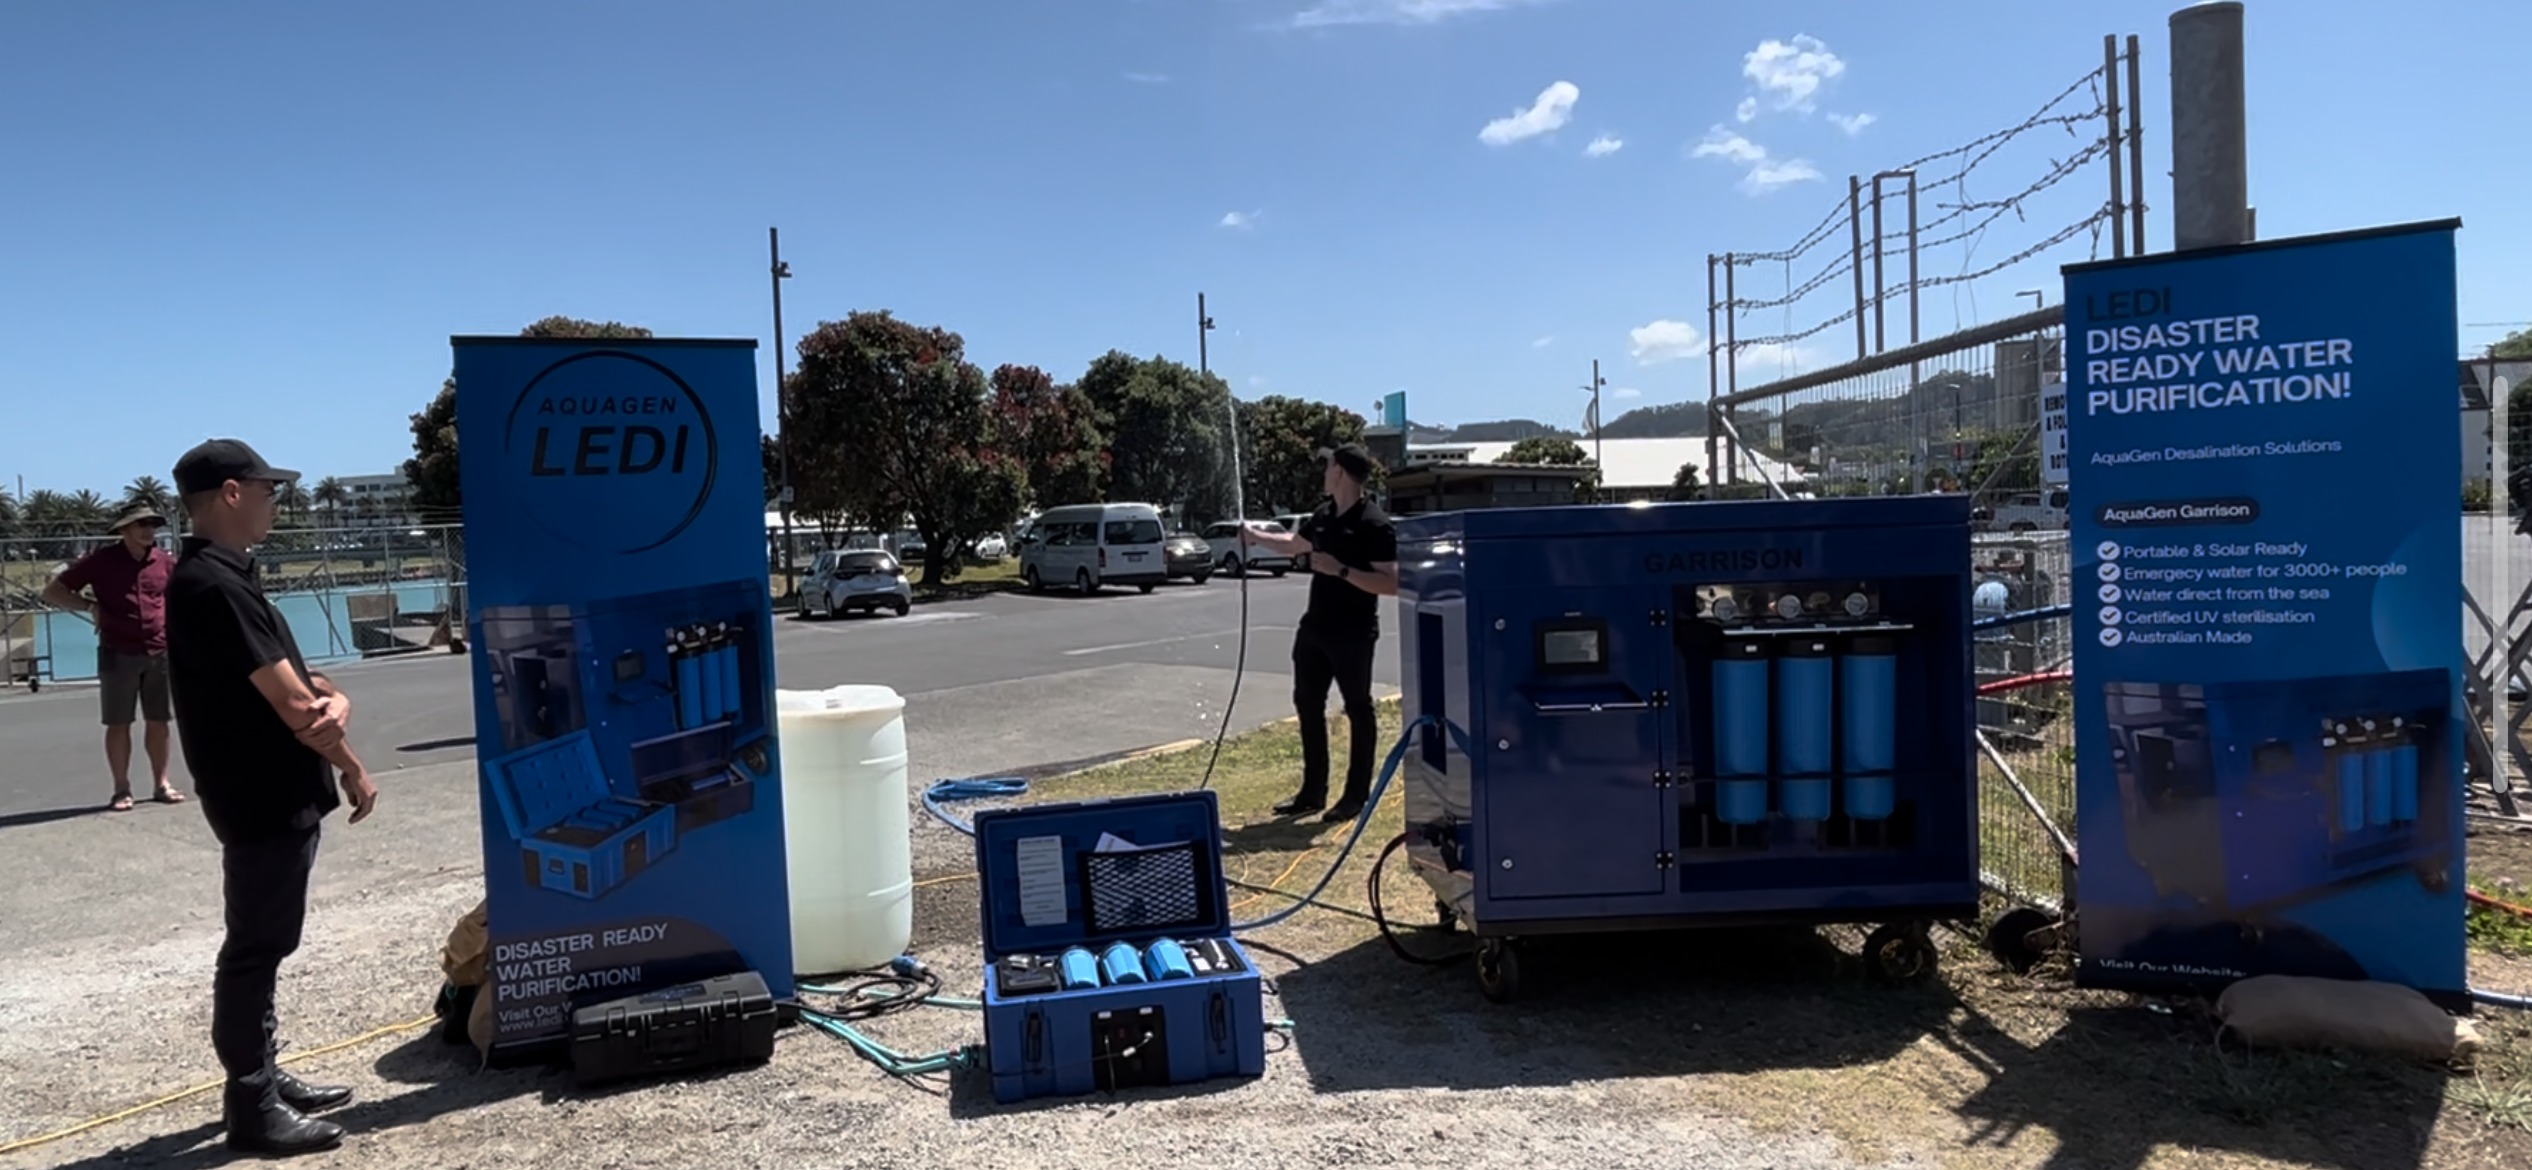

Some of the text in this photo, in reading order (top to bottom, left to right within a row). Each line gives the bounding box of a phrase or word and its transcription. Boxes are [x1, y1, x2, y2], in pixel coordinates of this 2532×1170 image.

[2086, 286, 2171, 321] LEDI
[2086, 314, 2260, 355] DISASTER
[2087, 339, 2353, 385] READY WATER
[538, 397, 677, 415] AQUAGEN
[2087, 372, 2352, 416] PURIFICATION!
[532, 425, 689, 475] LEDI
[2090, 438, 2342, 466] AquaGen Desalination Solutions
[2103, 503, 2250, 523] AquaGen Garrison
[1645, 548, 1803, 572] GARRISON
[2123, 541, 2307, 559] Portable & Solar Ready
[2123, 562, 2407, 583] Emergecy water for 3000+ people
[2124, 585, 2330, 602] Water direct from the sea
[2125, 609, 2315, 625] Certified UV sterilisation
[2126, 630, 2252, 645] Australian Made
[496, 923, 668, 962] DISASTER READY
[497, 957, 571, 982] WATER
[2099, 959, 2135, 969] Visit
[2138, 961, 2168, 971] Our
[498, 966, 642, 1001] PURIFICATION!
[498, 1007, 530, 1022] Visit
[533, 1004, 559, 1018] Our
